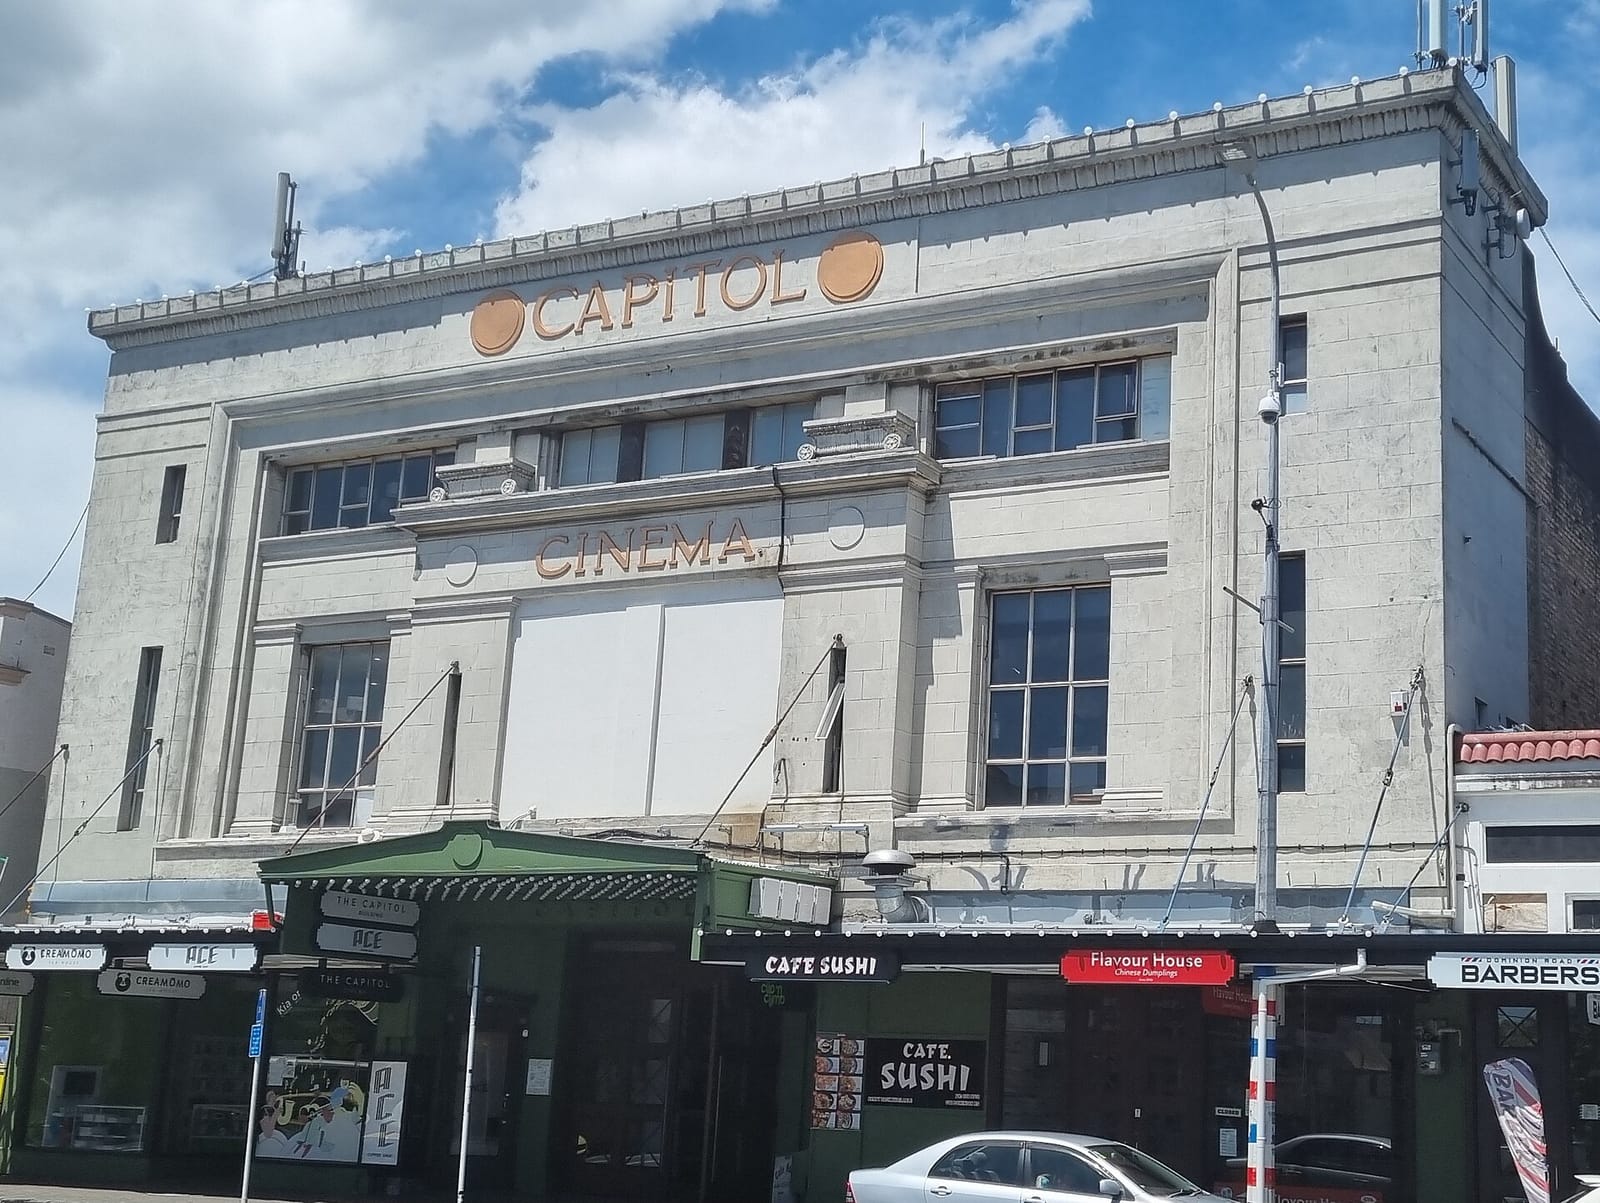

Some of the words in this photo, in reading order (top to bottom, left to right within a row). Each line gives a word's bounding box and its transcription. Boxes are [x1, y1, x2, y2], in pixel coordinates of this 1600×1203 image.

[532, 248, 807, 341] CAPITOL
[535, 517, 756, 580] CINEMA
[337, 896, 357, 907] THE
[362, 899, 406, 913] CAPITOL
[353, 929, 382, 949] ACE
[185, 946, 219, 964] ACE
[1091, 952, 1148, 967] Flavour
[1153, 953, 1203, 968] House
[765, 956, 815, 975] CAFE
[820, 956, 877, 975] SUSHI
[1114, 968, 1141, 977] Chinese
[1142, 968, 1178, 978] Dumplings
[1461, 964, 1600, 985] BARBERS
[136, 976, 191, 988] CREAMOMO
[320, 974, 340, 984] THE
[346, 977, 390, 988] CAPITOL
[276, 1000, 292, 1015] Kia
[881, 1062, 970, 1091] SUSHI
